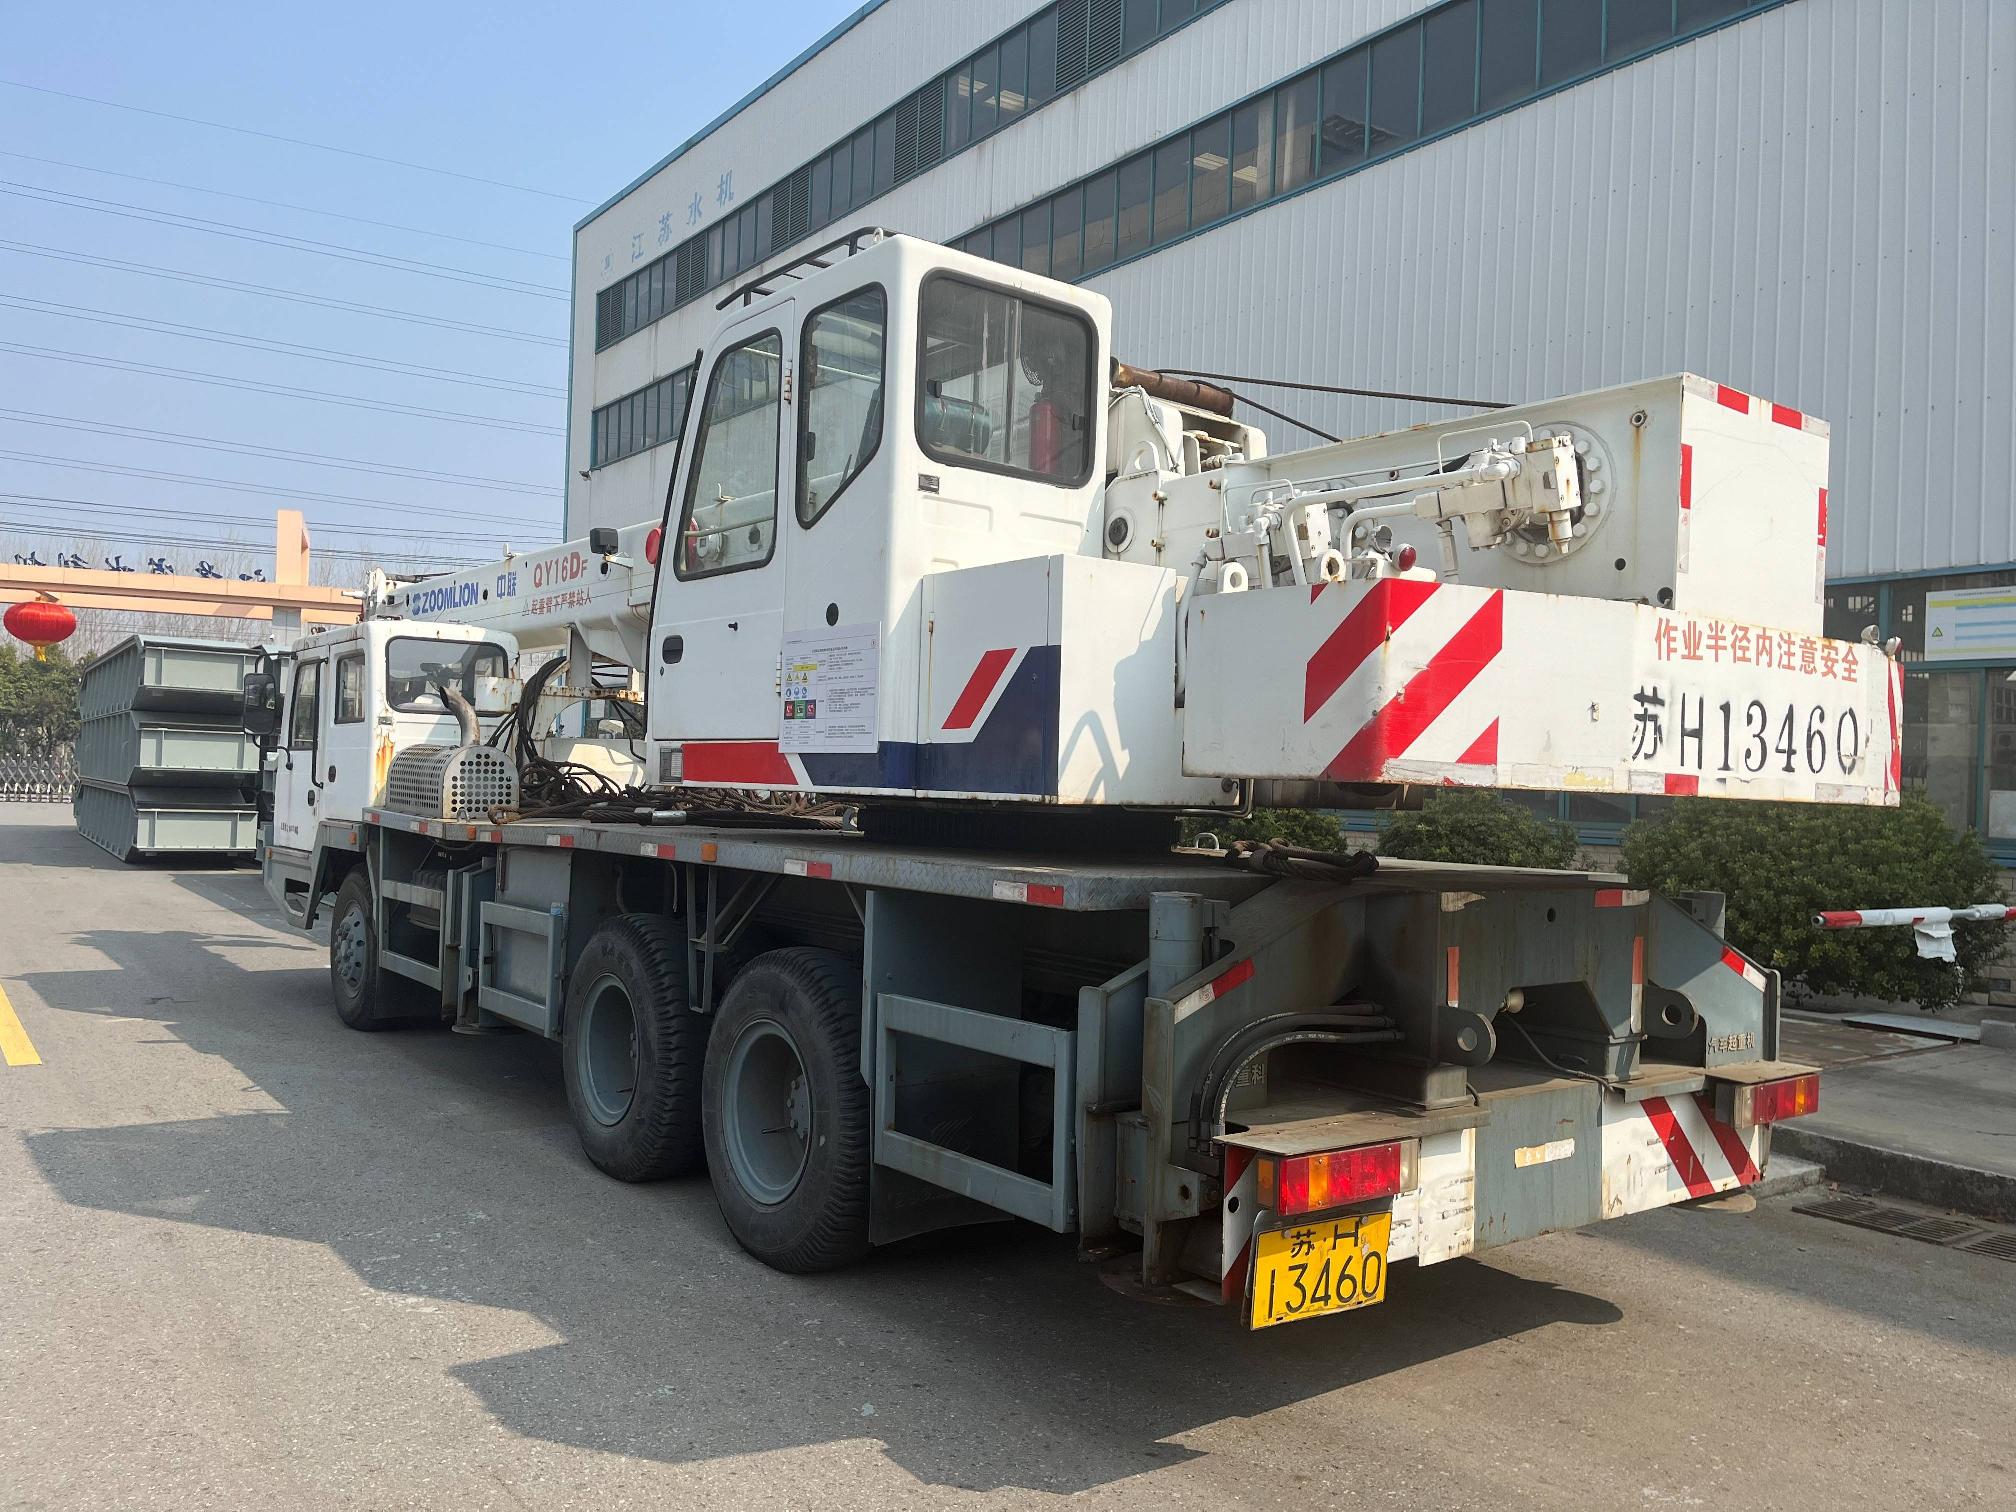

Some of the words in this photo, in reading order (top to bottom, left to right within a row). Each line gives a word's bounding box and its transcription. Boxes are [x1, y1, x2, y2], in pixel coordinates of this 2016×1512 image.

[632, 169, 734, 263] 江苏水机
[421, 582, 479, 613] ZOOMLION
[496, 571, 516, 598] 中联
[1655, 617, 1859, 683] 作业半径内注意安全
[1267, 1250, 1382, 1320] 13460
